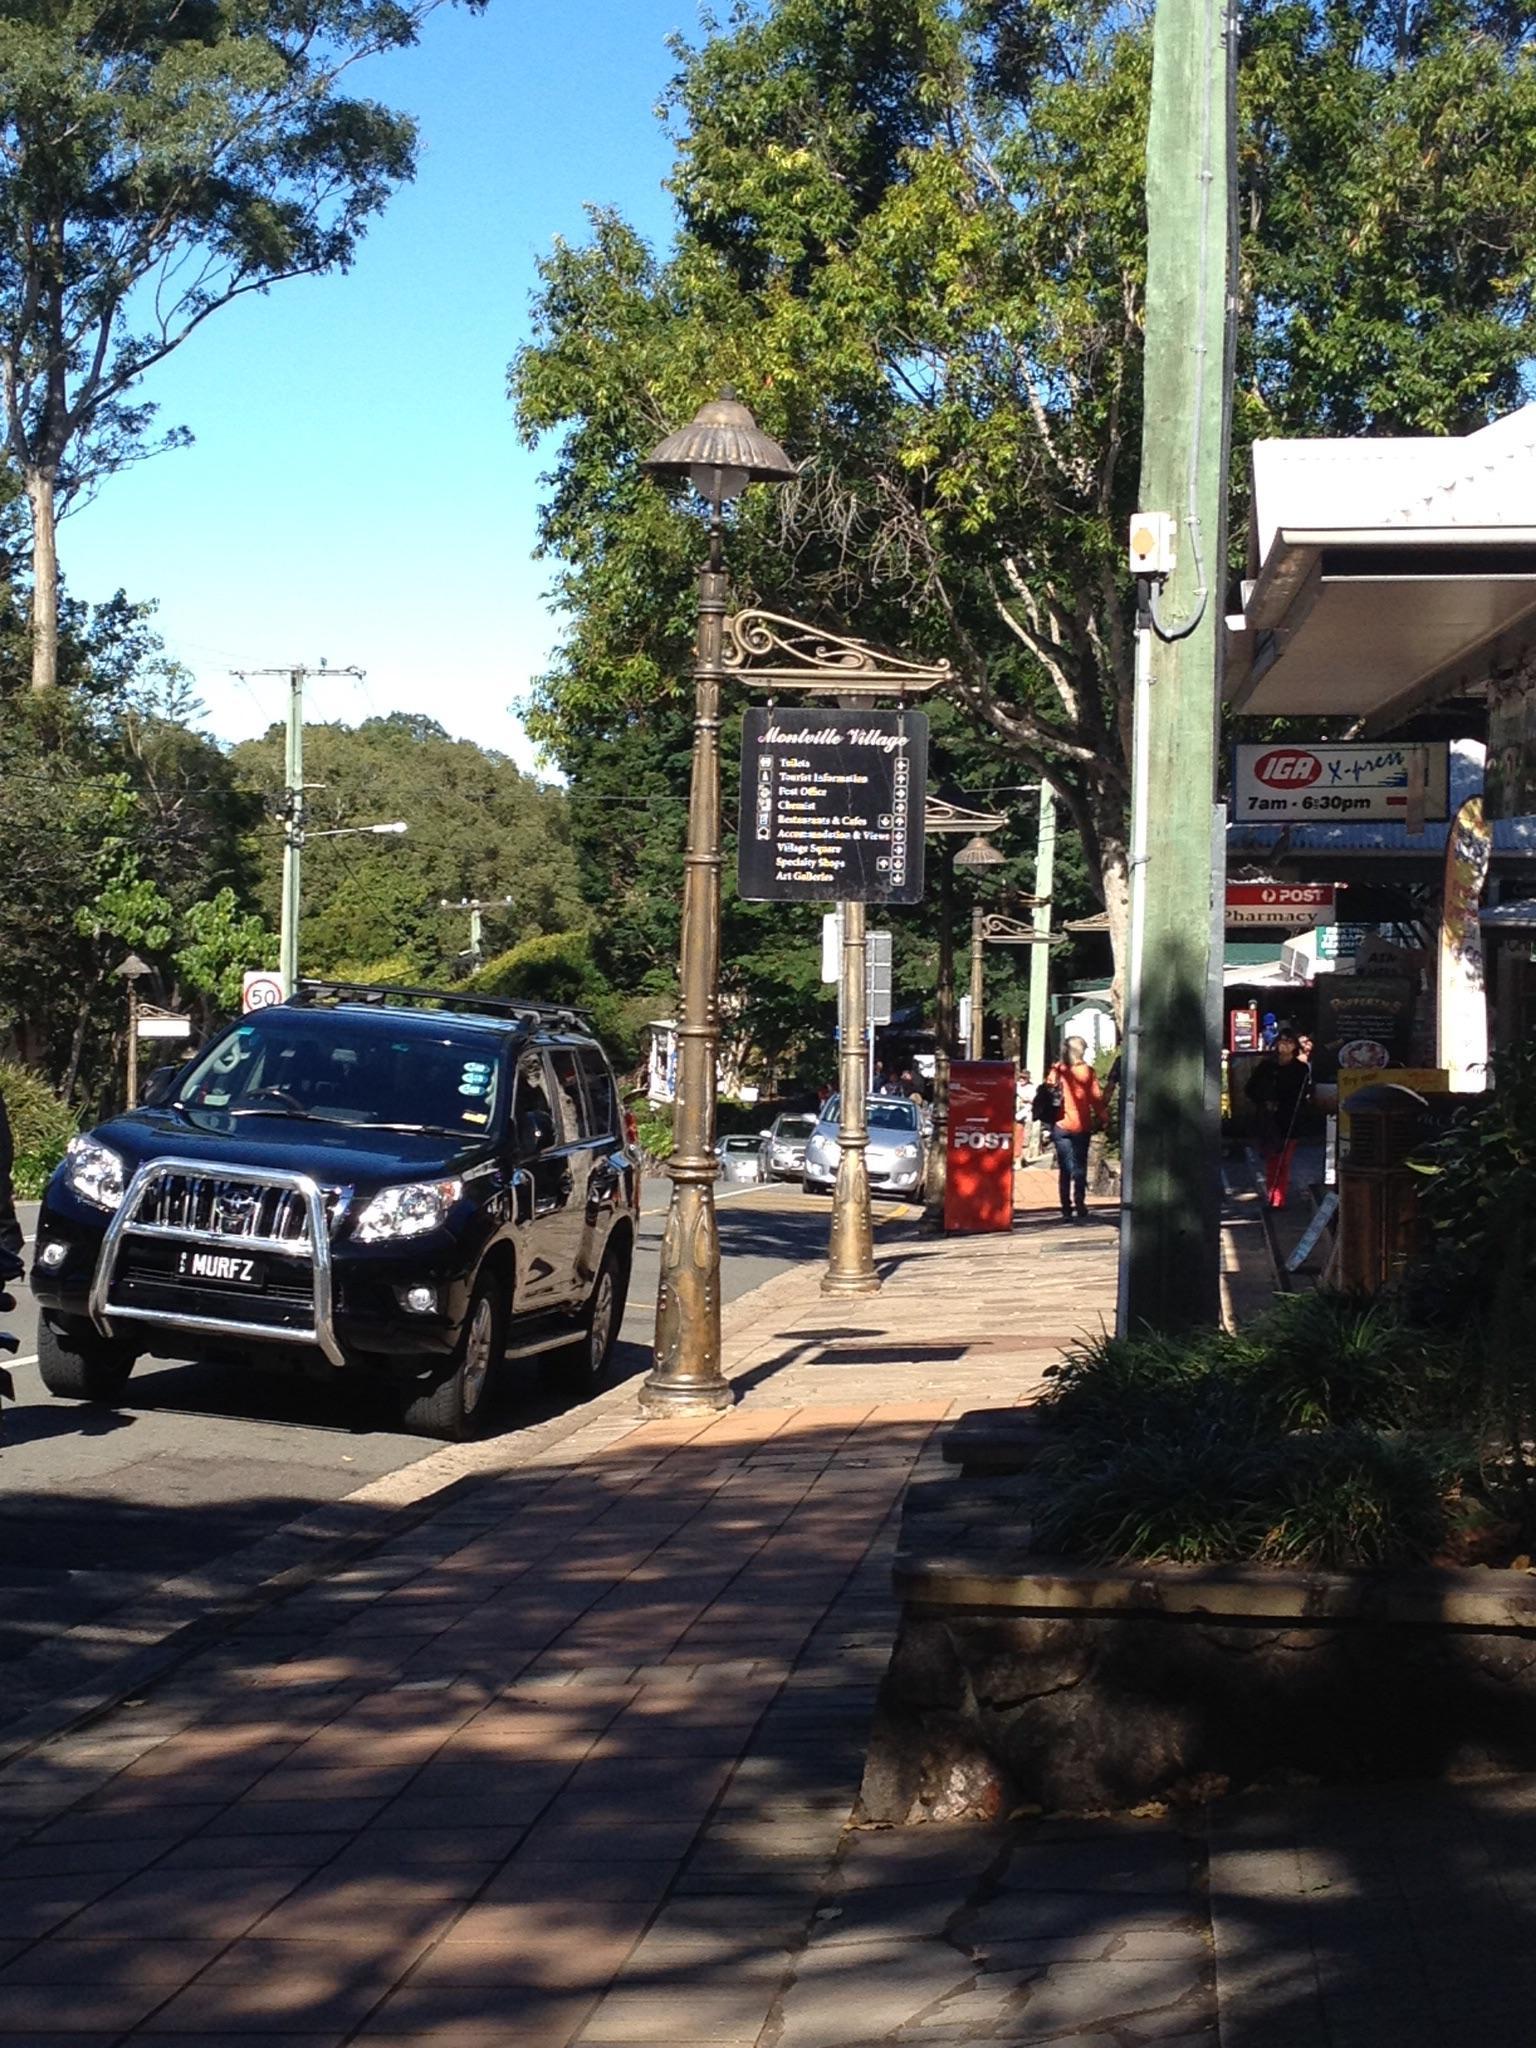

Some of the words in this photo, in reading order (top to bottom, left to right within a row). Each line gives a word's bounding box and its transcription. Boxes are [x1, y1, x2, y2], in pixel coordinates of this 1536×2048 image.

[847, 728, 911, 753] Village
[779, 758, 811, 768] Toilets
[1261, 756, 1312, 781] IGA
[778, 772, 812, 782] Tourist
[813, 772, 869, 784] Information
[778, 786, 798, 796] Post
[800, 787, 827, 797] Office
[777, 800, 816, 810] Chemist
[1247, 796, 1288, 811] 7am
[777, 815, 831, 825] Restaurants
[832, 815, 840, 825] &
[841, 816, 867, 826] Cafes
[853, 829, 862, 840] &
[863, 830, 890, 841] Views
[776, 843, 809, 854] Village
[810, 844, 842, 855] Square
[818, 857, 845, 870] Shops
[775, 872, 792, 881] Art
[793, 872, 834, 882] Galleries
[1278, 889, 1324, 902] POST
[252, 989, 276, 1006] 50
[954, 1131, 1013, 1150] POST
[191, 1253, 255, 1281] MURFZ
